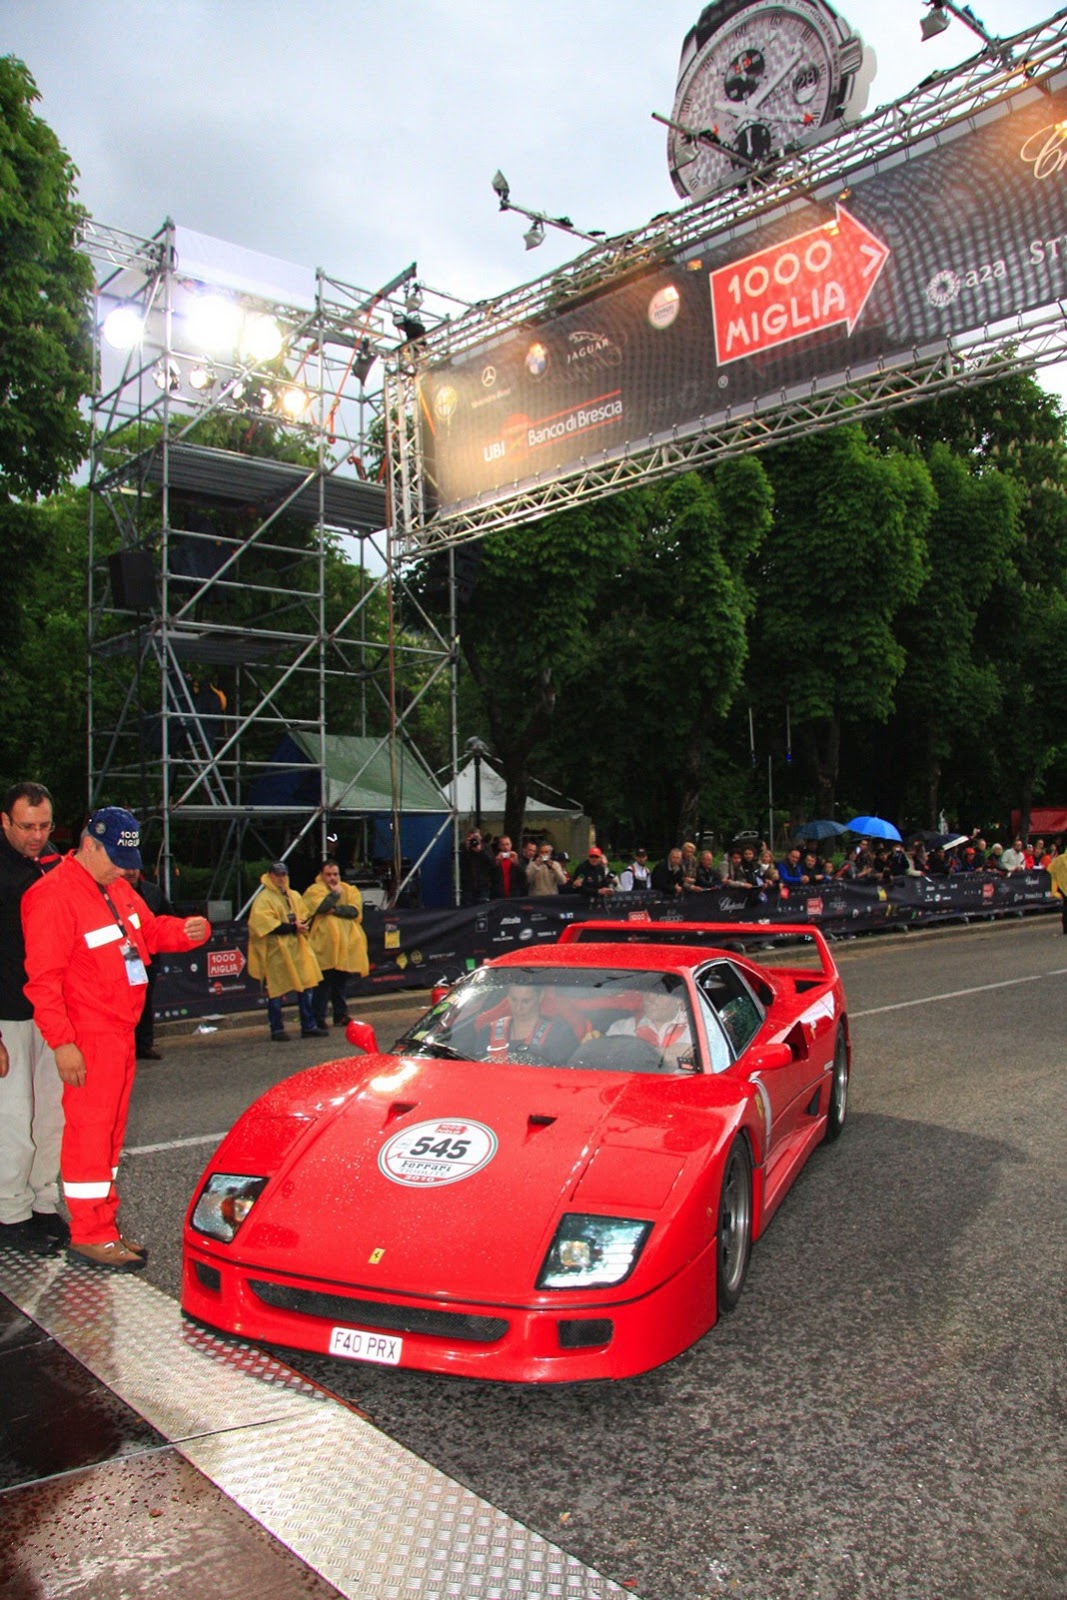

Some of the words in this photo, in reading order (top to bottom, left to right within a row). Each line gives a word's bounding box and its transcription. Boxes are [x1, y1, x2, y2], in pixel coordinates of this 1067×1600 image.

[797, 69, 815, 88] 28
[728, 240, 832, 304] 1000
[966, 260, 1007, 287] a2a
[725, 281, 845, 352] MIGLIA
[566, 338, 609, 364] JAGUAR
[528, 422, 565, 446] Banco
[565, 415, 577, 432] di
[578, 400, 623, 428] Brescia
[483, 440, 505, 461] UBI
[211, 964, 238, 974] MIGLIA
[212, 953, 236, 963] 1000
[410, 1136, 471, 1159] 545
[401, 1160, 453, 1172] Ferrari
[334, 1331, 362, 1353] F40
[366, 1337, 397, 1359] PRX
